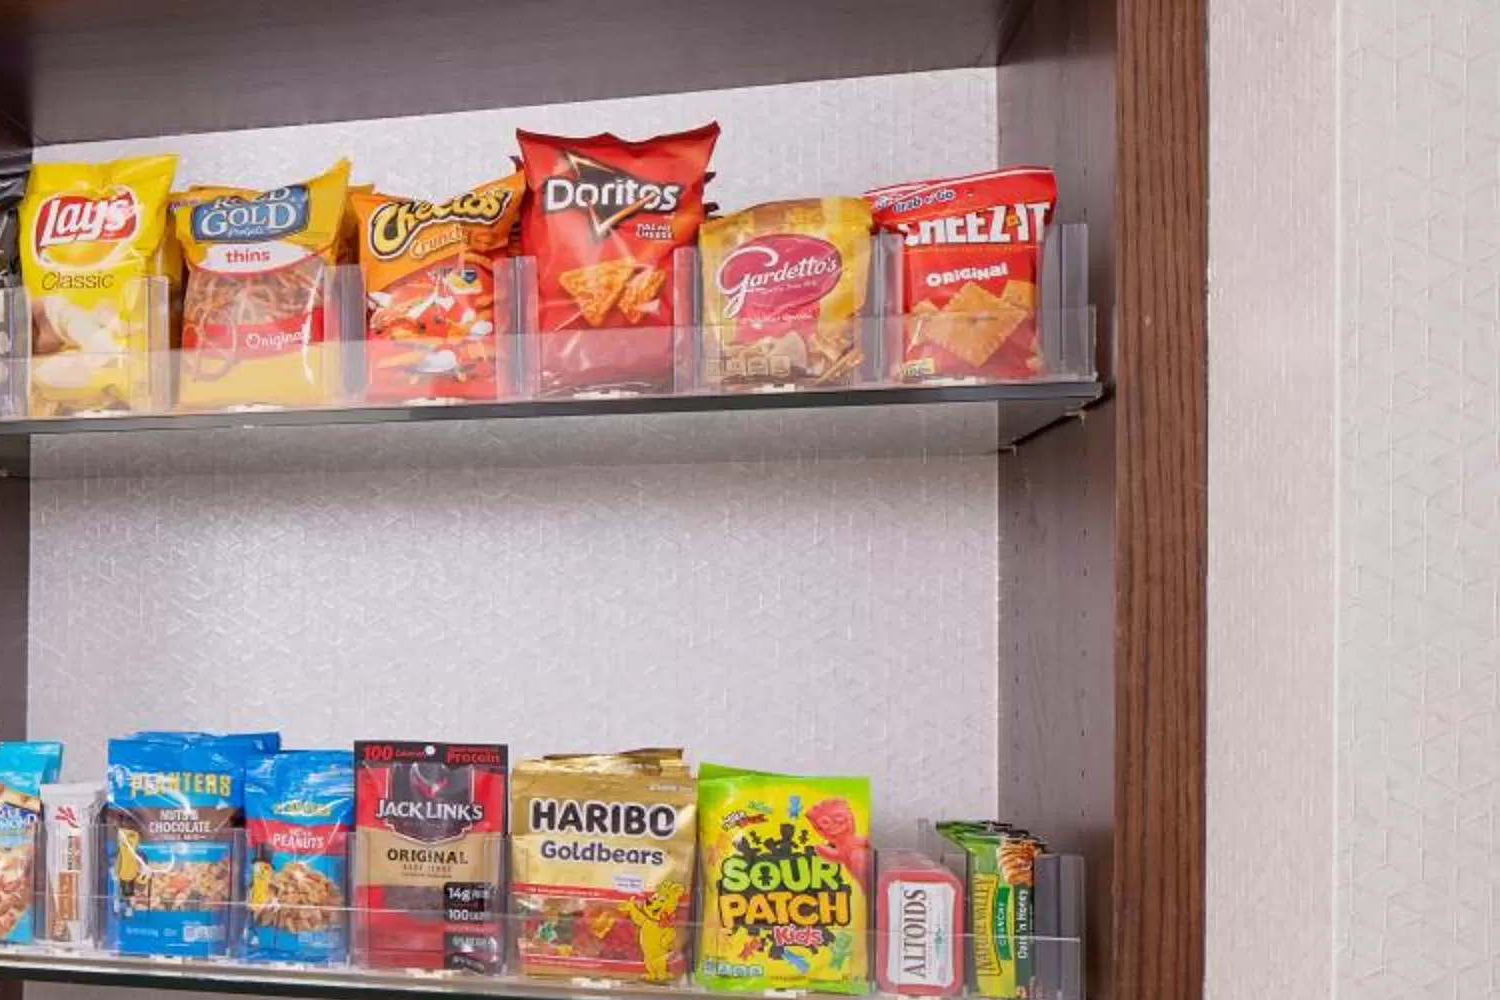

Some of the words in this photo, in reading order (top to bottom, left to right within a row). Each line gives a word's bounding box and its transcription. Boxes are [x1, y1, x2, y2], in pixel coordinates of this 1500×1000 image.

[546, 178, 680, 212] Doritos
[201, 202, 297, 235] GOLD
[225, 249, 271, 264] thins
[41, 270, 115, 291] Classic
[716, 245, 837, 319] Gardetto's
[363, 745, 394, 761] 100
[447, 747, 500, 765] Protein
[375, 799, 424, 820] JACK
[532, 801, 676, 836] HARIBO
[148, 821, 211, 833] CHOCOLATE
[387, 848, 469, 865] ORIGINAL
[541, 841, 664, 866] Goldbears
[721, 856, 841, 892] SOUR
[719, 890, 850, 928] PATCH
[903, 888, 927, 979] ALTOIDS
